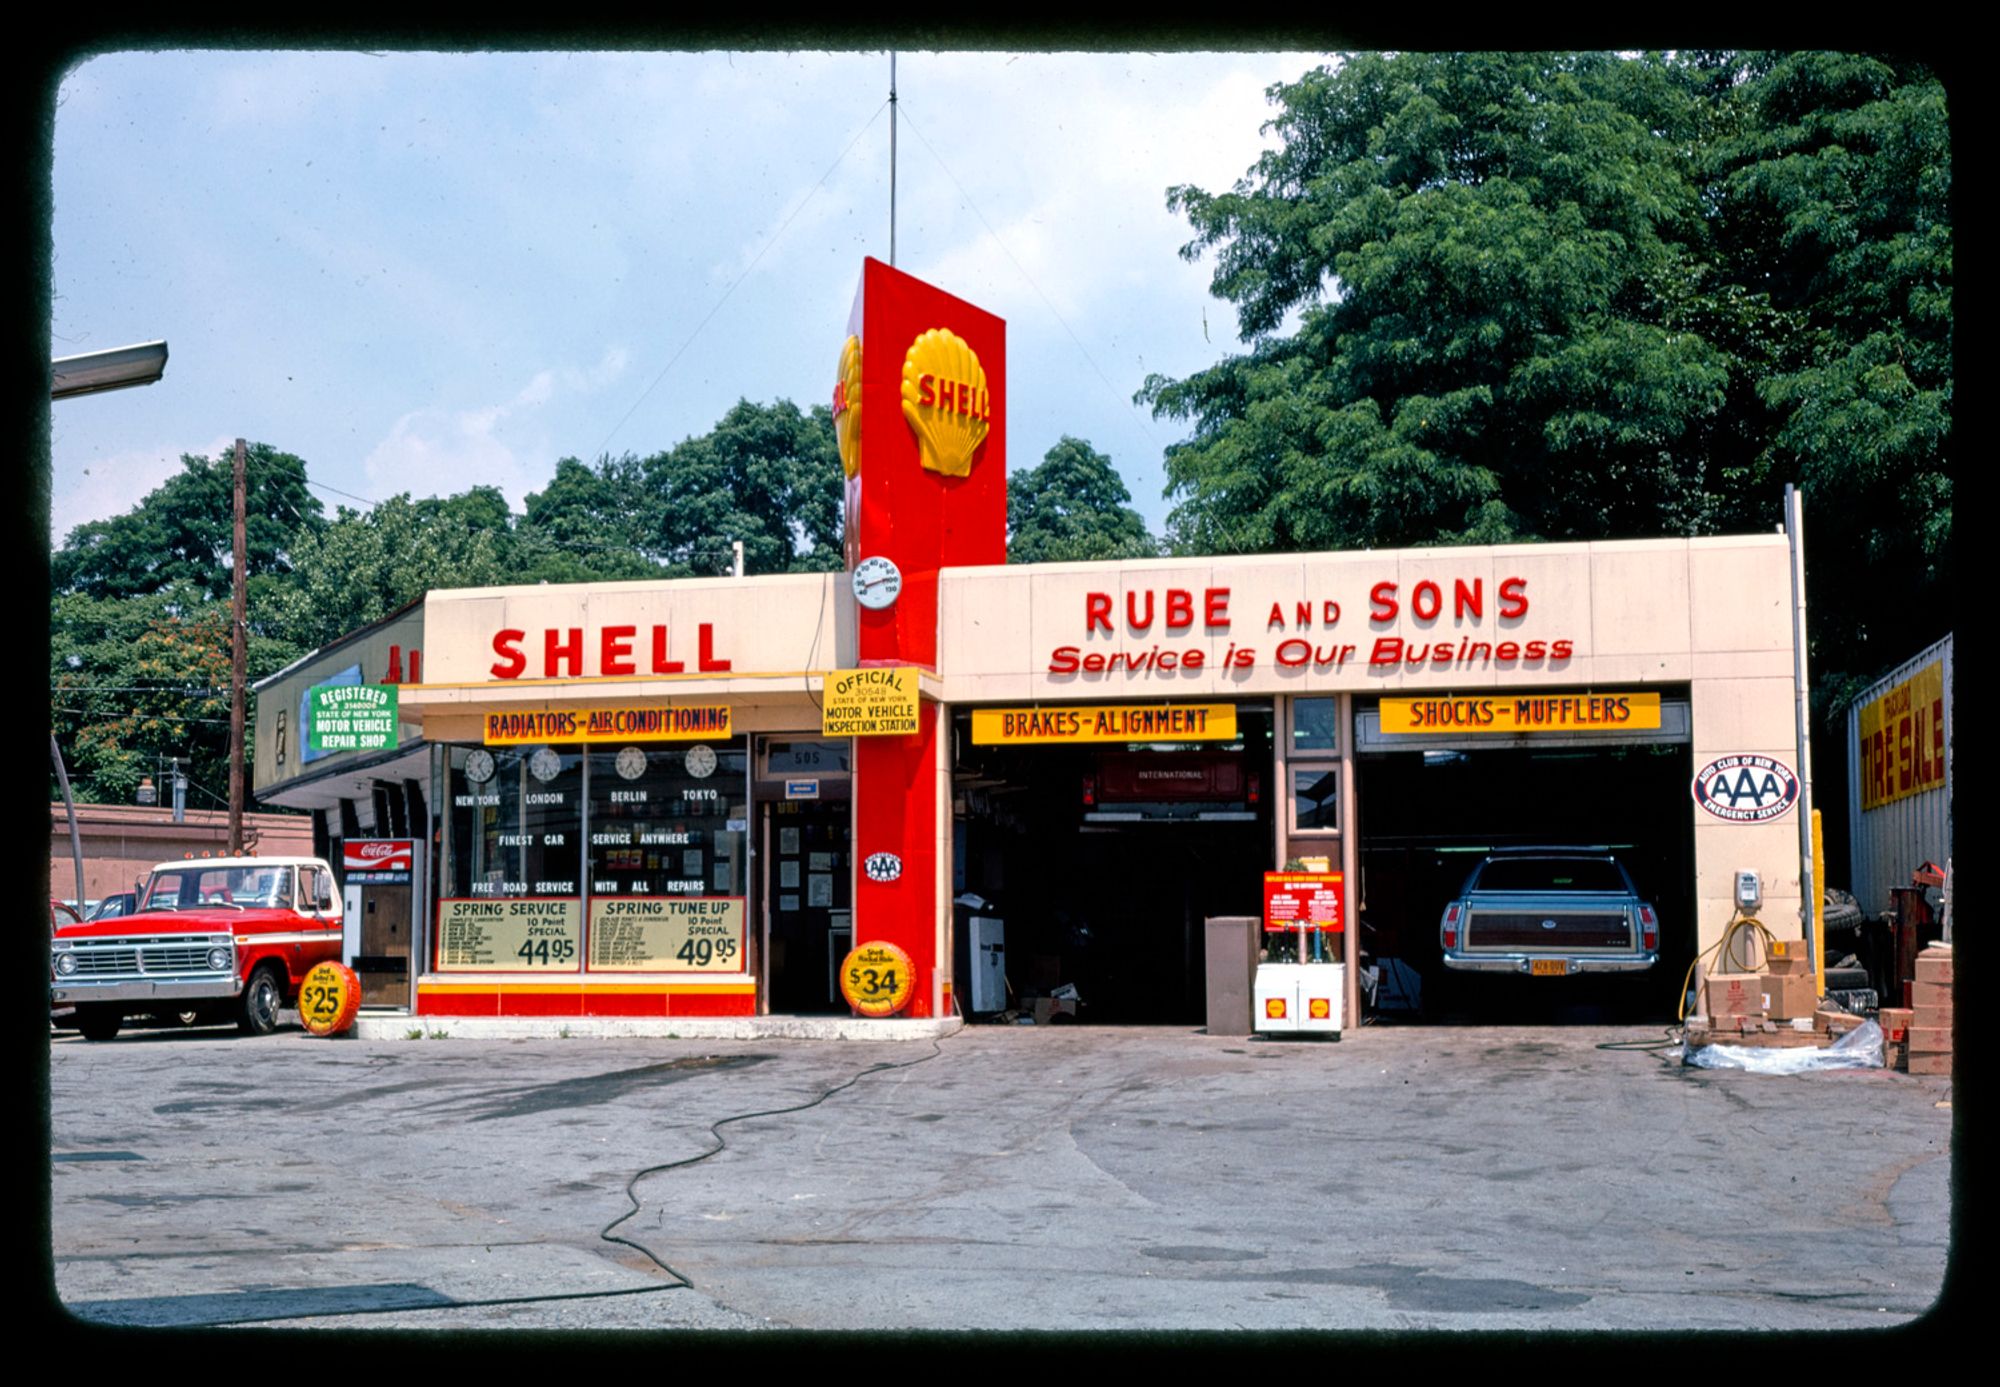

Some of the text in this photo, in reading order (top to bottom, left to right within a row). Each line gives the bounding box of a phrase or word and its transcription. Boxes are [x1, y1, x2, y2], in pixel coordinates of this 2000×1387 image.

[919, 374, 990, 423] SHELL
[1086, 577, 1529, 631] RUBE AND SONS
[490, 623, 732, 679] SHELL
[1048, 636, 1573, 673] Service is Our Business
[836, 671, 902, 694] OFFICIAL
[320, 686, 388, 706] REGISTERED
[833, 697, 855, 705] STATE
[888, 695, 907, 703] YORK
[316, 710, 339, 719] STATE
[341, 710, 351, 718] OF
[353, 710, 369, 718] NEW
[826, 704, 914, 719] MOTOR VEHICLE
[316, 719, 392, 732] MOTOR VEHICLE
[824, 718, 917, 733] INSPECTION STATION
[322, 734, 387, 747] REPAIR SHOP
[1861, 698, 1944, 804] TIRE SALE
[794, 752, 821, 764] 505
[1138, 770, 1203, 779] INTERNATIONAL
[1699, 757, 1792, 784] AUTO CLUB OF NEW YORK
[1711, 768, 1781, 807] AAA
[455, 795, 500, 806] NEW YORK
[526, 793, 564, 804] LONDON
[610, 791, 647, 802] BERLIN
[682, 789, 717, 800] TOKYO
[1703, 799, 1790, 819] EMERGENCY SERVICE
[499, 833, 689, 846] FINEST CAR SERVICE ANYWHERE
[871, 857, 897, 877] AAA
[472, 881, 704, 892] FREE ROAD SERVICE WITH ALL REPAIRS
[453, 903, 567, 916] SPRING SERVICE
[606, 902, 731, 915] SPRING TUNE UP
[527, 917, 565, 926] 10 Point
[688, 917, 723, 925] 10 Point
[528, 927, 566, 936] SPECIAL
[687, 926, 729, 935] SPECIAL
